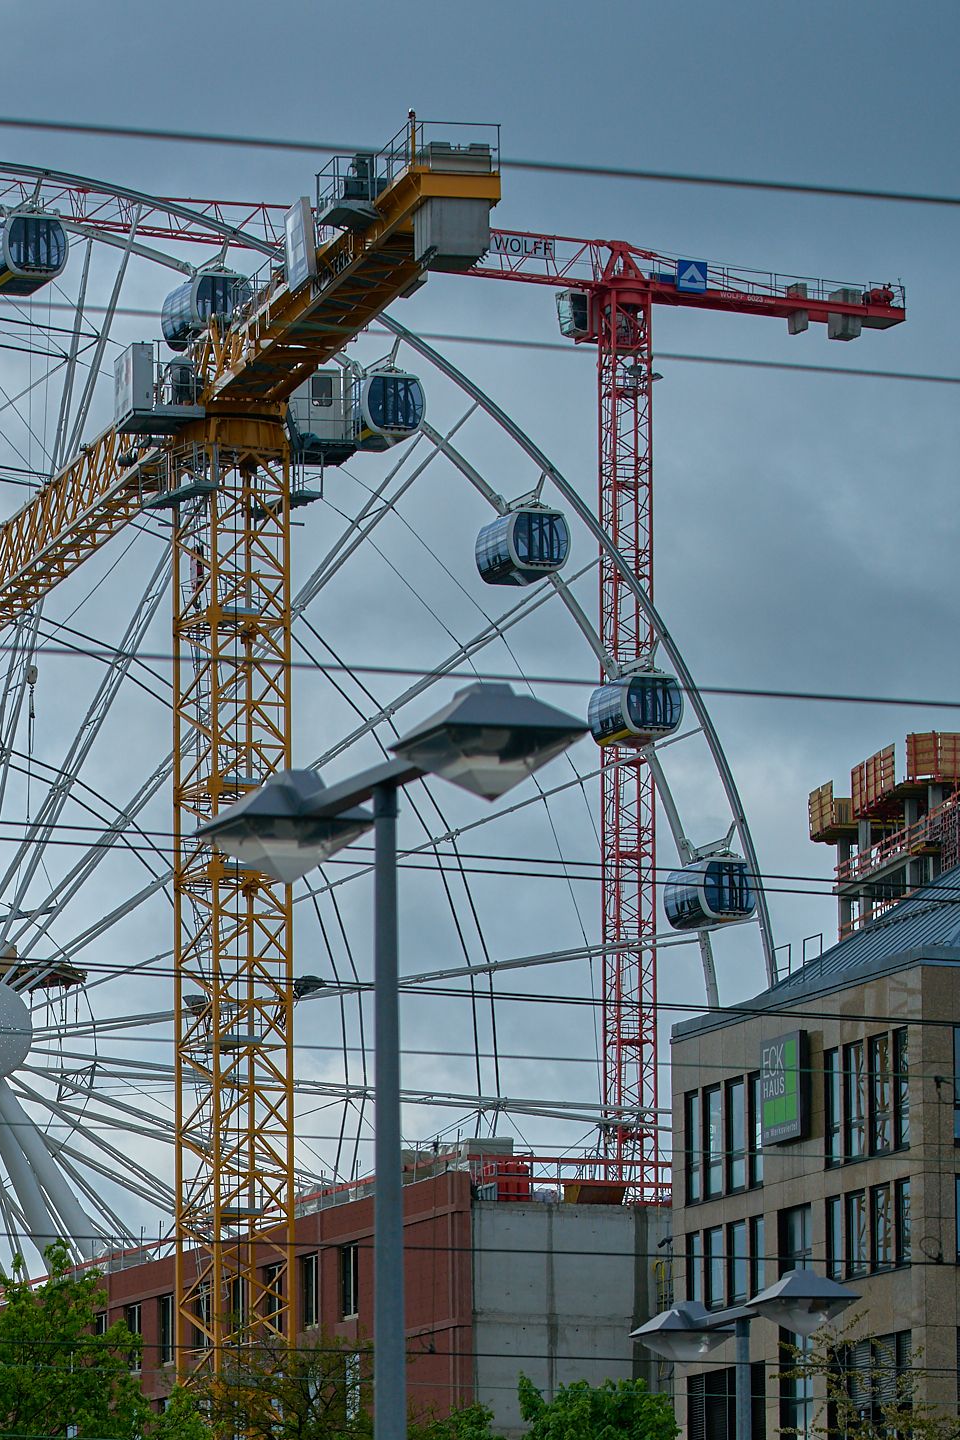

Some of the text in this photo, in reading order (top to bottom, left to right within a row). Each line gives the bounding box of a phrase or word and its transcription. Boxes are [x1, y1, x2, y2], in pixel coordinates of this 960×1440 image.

[494, 236, 553, 256] WOLFF
[720, 291, 745, 300] WOLFF
[747, 294, 764, 303] 6023
[762, 1043, 785, 1079] ECK
[763, 1076, 785, 1099] HAUS
[770, 1121, 798, 1137] Werksviertel
